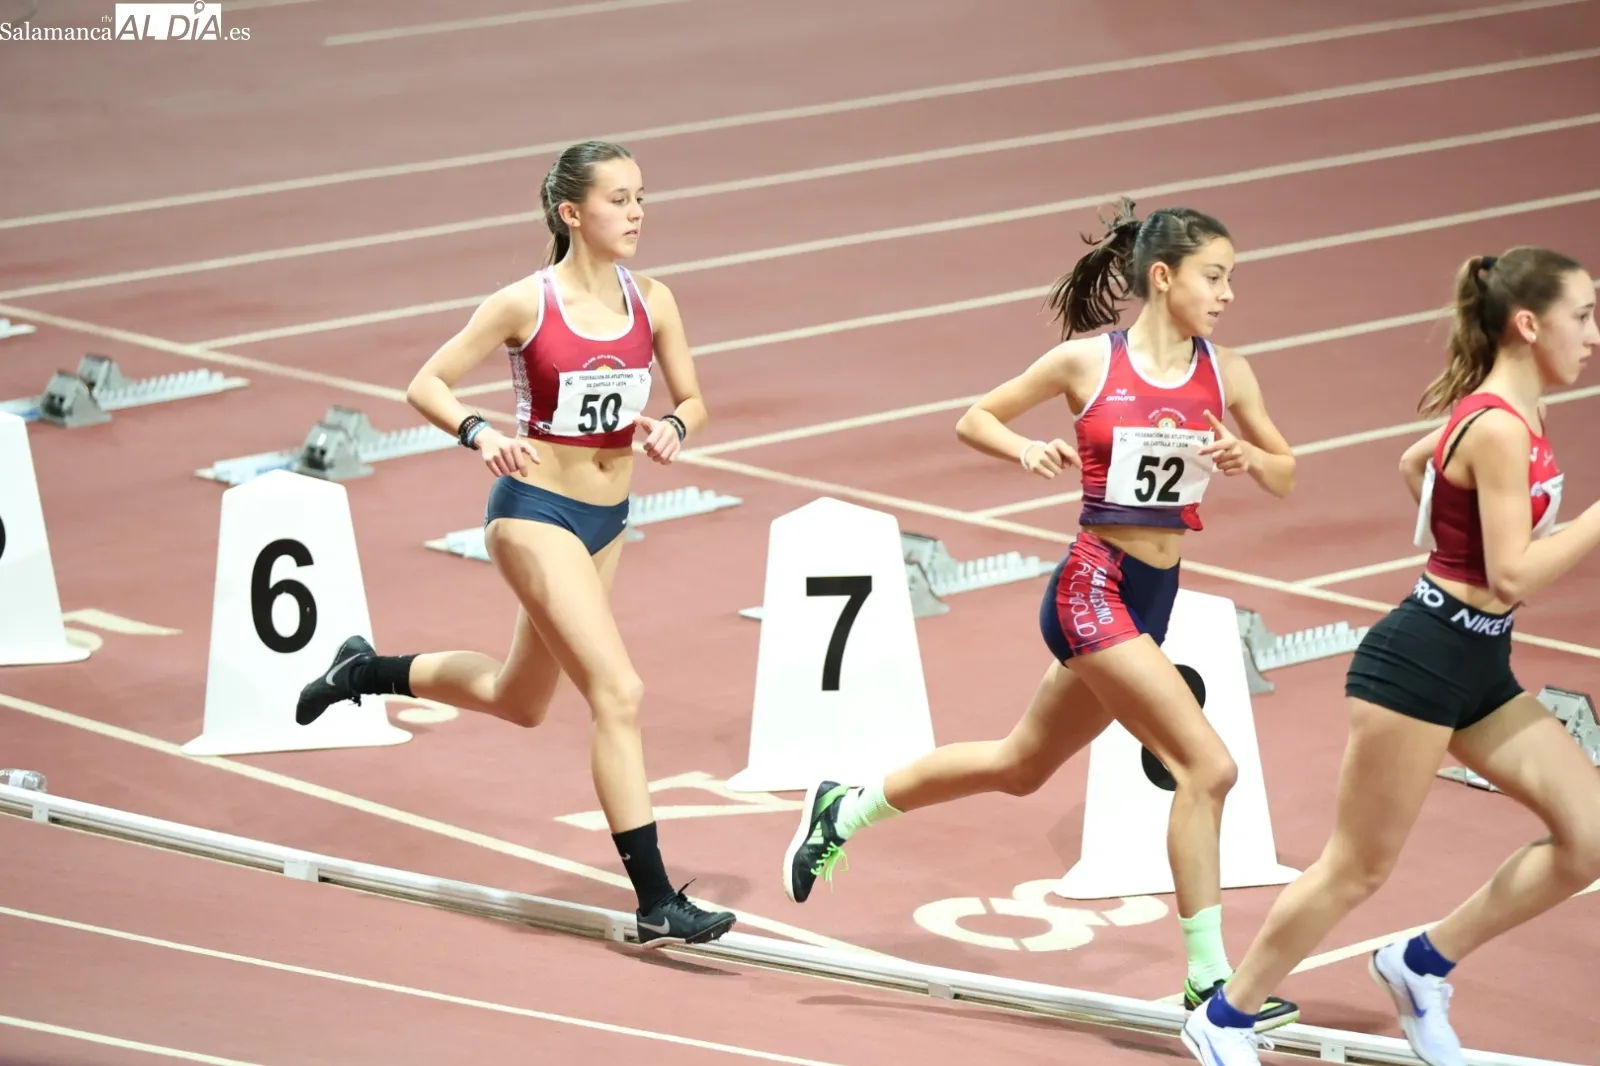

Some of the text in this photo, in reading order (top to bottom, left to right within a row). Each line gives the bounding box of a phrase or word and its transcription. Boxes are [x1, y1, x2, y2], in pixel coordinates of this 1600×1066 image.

[577, 393, 622, 434] 50
[1134, 455, 1185, 503] 52
[250, 538, 318, 654] 6
[805, 575, 873, 691] 7
[1451, 608, 1504, 636] NIKE
